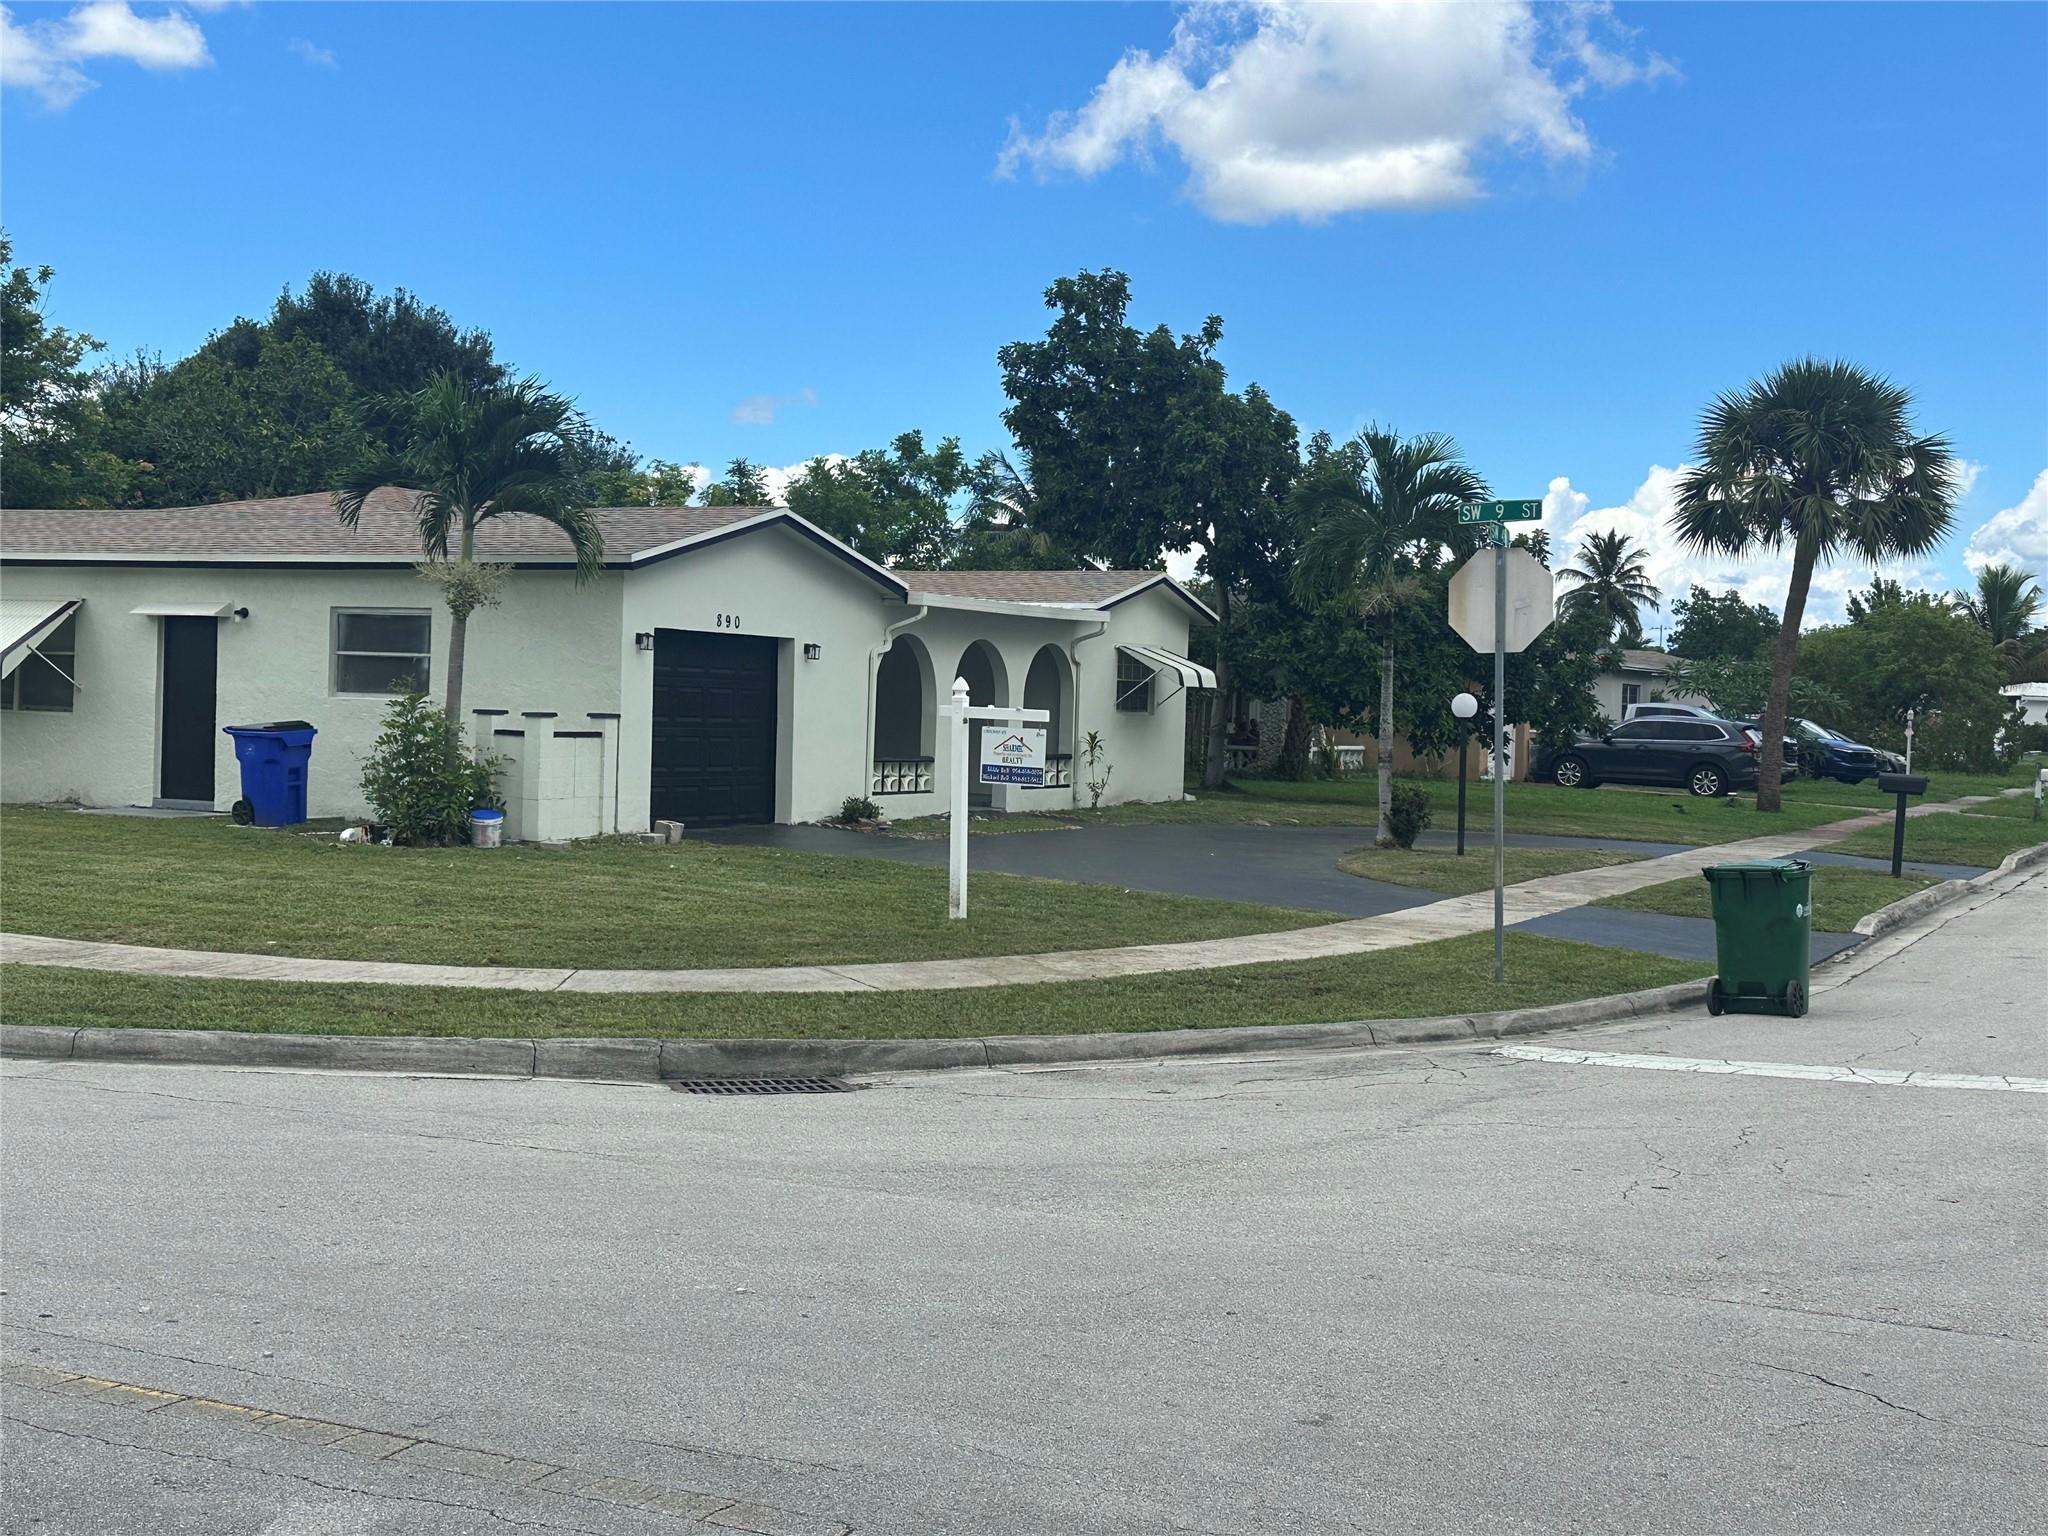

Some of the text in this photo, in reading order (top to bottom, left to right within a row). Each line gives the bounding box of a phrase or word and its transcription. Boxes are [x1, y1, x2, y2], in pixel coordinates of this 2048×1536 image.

[1462, 503, 1538, 520] SW 9 ST
[716, 613, 740, 629] 890
